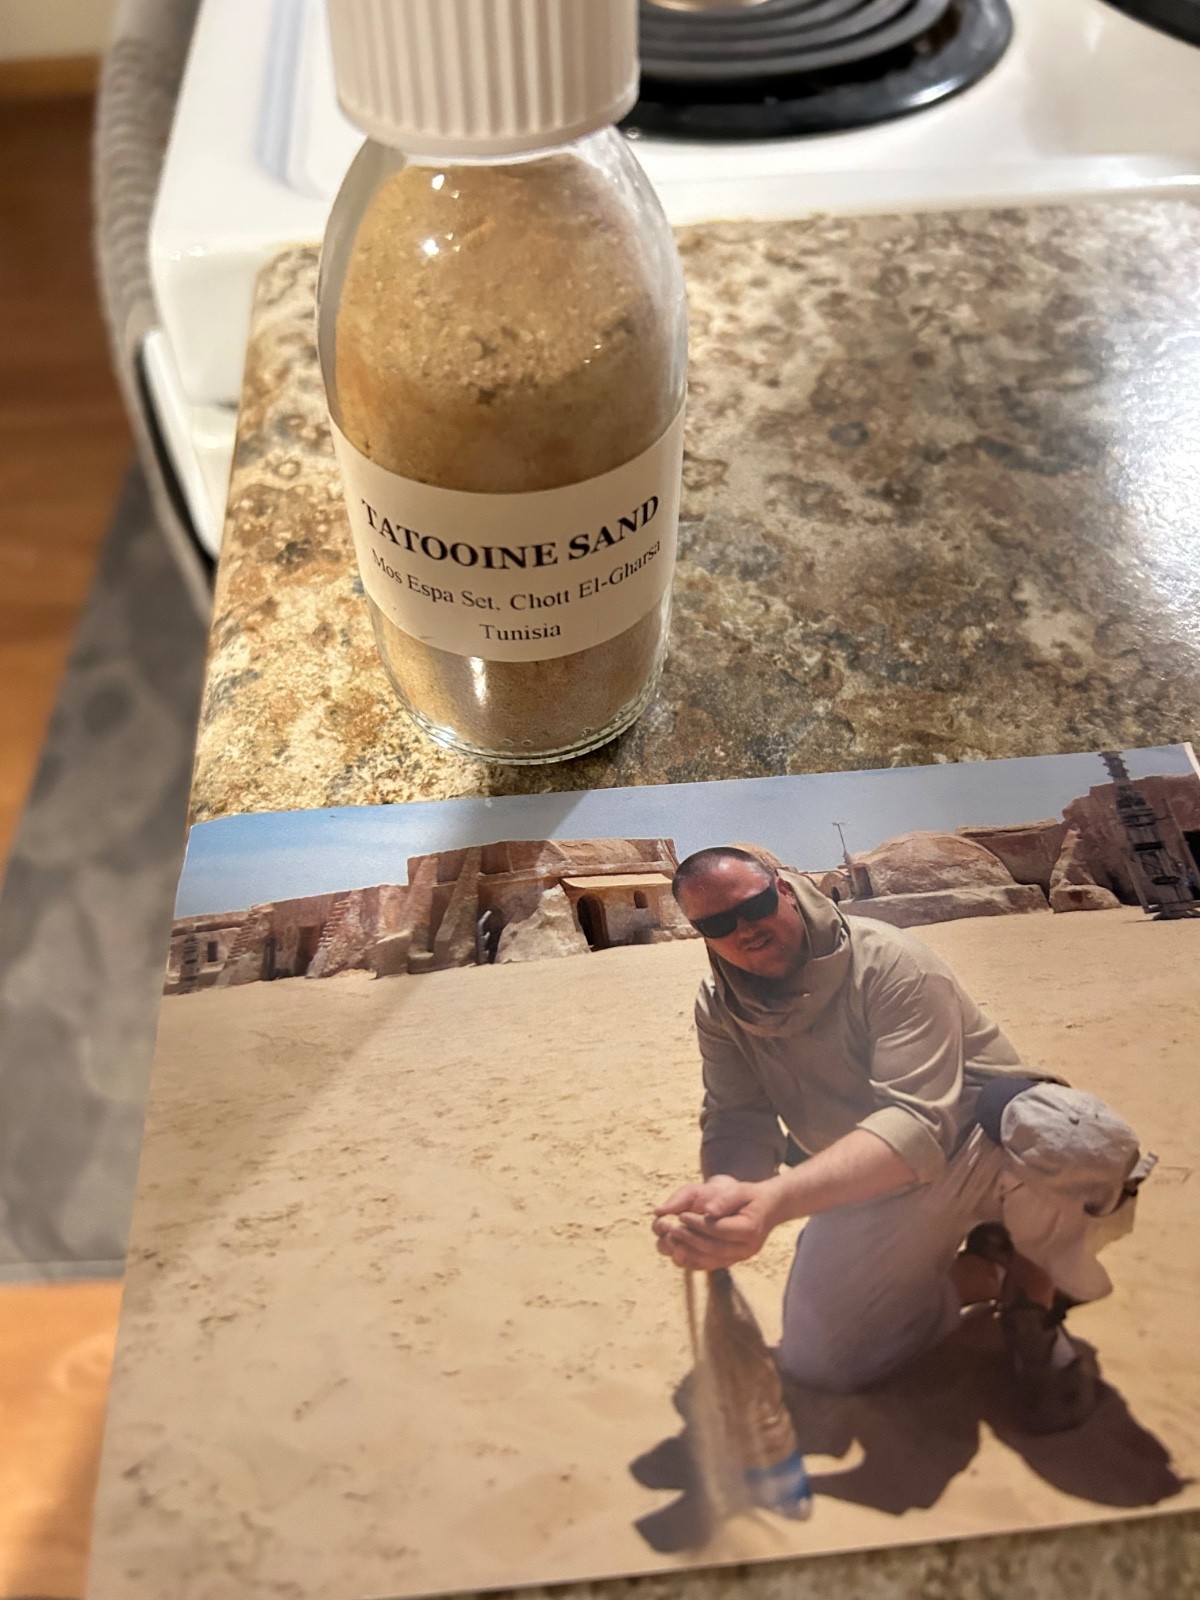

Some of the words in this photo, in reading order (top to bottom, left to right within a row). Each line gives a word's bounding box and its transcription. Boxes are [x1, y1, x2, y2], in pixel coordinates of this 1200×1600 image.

[361, 499, 559, 569] TATOOINE
[568, 495, 661, 561] SAND
[371, 547, 403, 583] Mos
[407, 574, 454, 604] Espa
[510, 589, 570, 611] Chott
[579, 540, 661, 599] El-Gharsa
[479, 623, 562, 641] Tunisia
